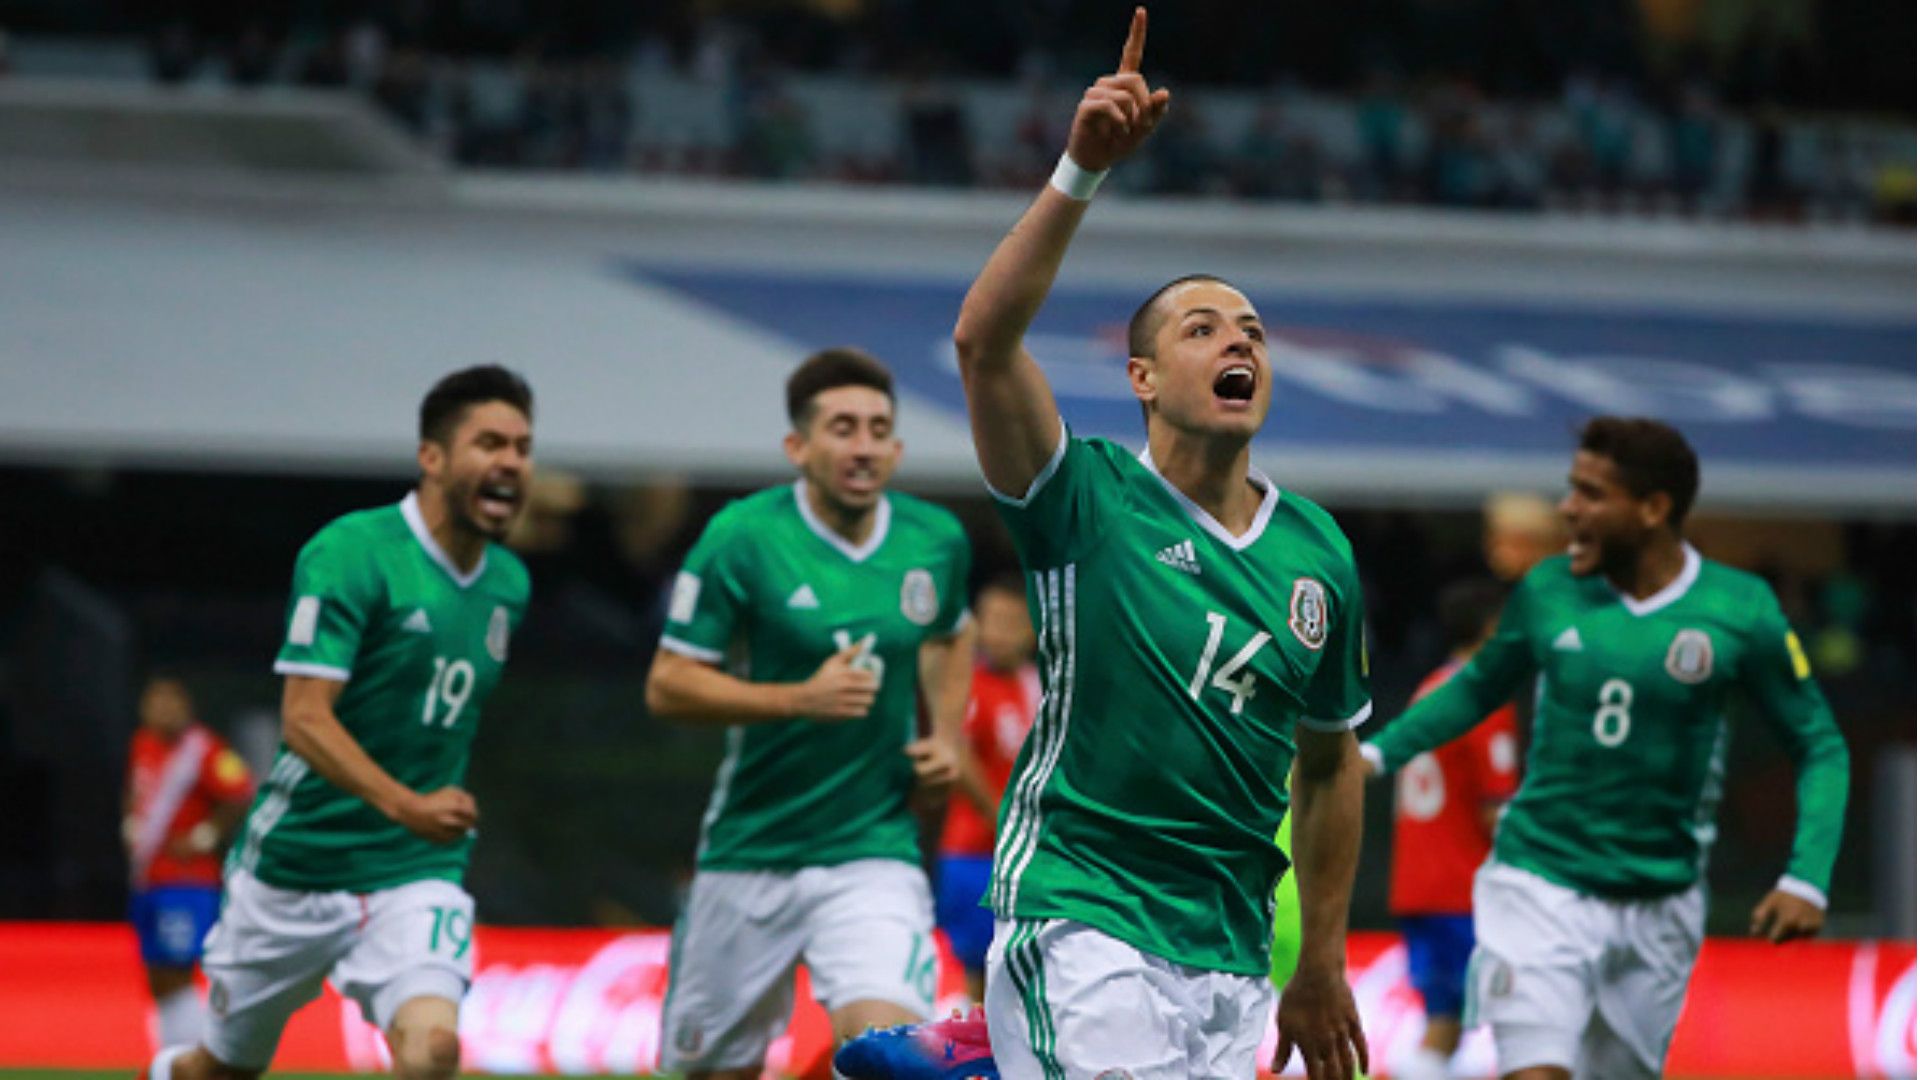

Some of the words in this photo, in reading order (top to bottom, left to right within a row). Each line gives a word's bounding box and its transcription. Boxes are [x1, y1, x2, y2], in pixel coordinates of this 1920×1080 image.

[421, 656, 475, 728] 19
[1188, 611, 1272, 715] 14
[1593, 679, 1634, 748] 8
[426, 906, 471, 960] 19
